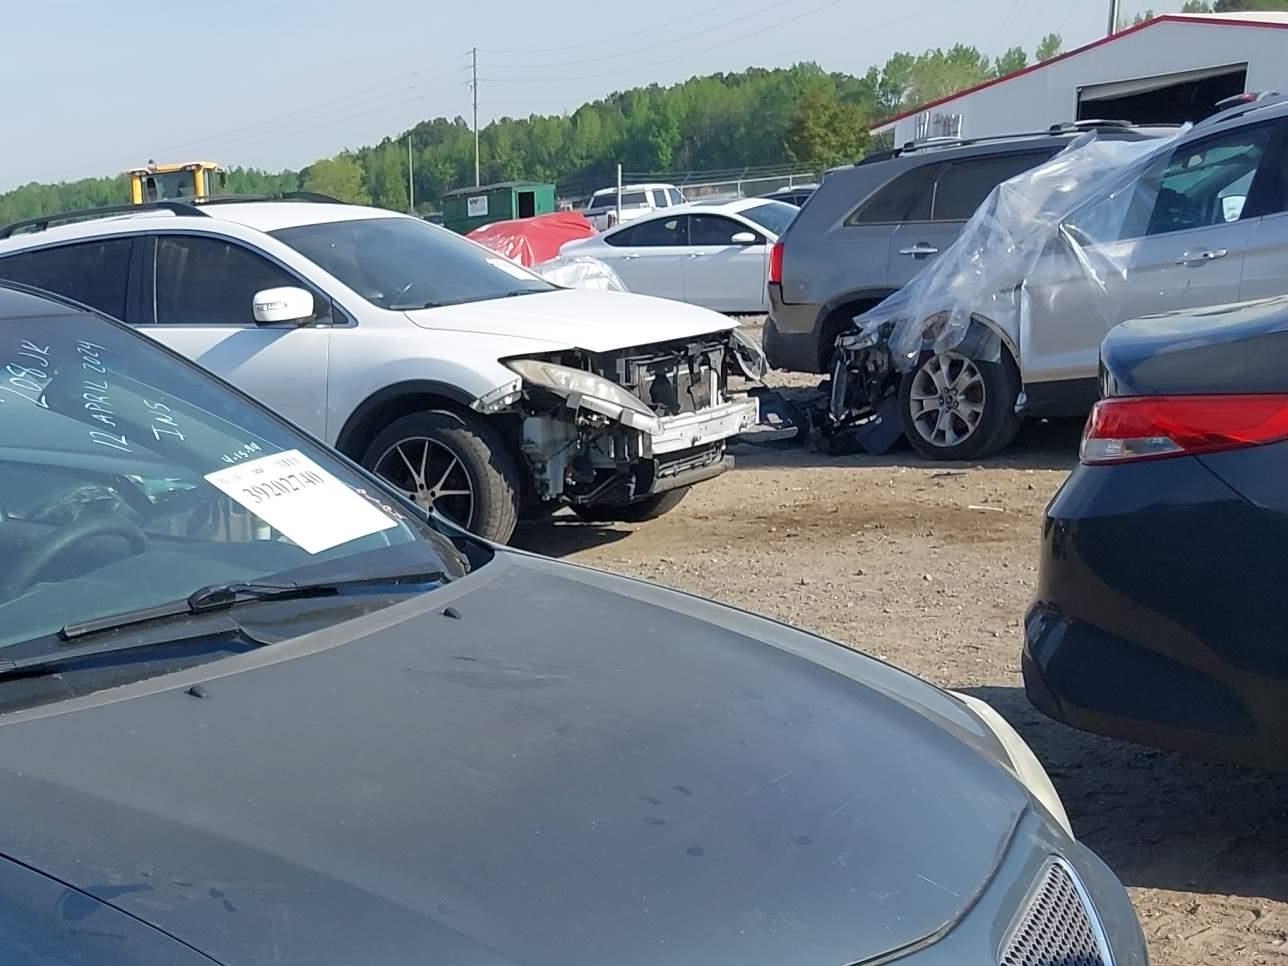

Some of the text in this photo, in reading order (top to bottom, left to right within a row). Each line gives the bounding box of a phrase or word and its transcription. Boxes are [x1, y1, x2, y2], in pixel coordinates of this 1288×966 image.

[76, 339, 132, 452] 12 APRIL 2024
[143, 399, 186, 441] INS
[242, 471, 325, 504] 39202740
